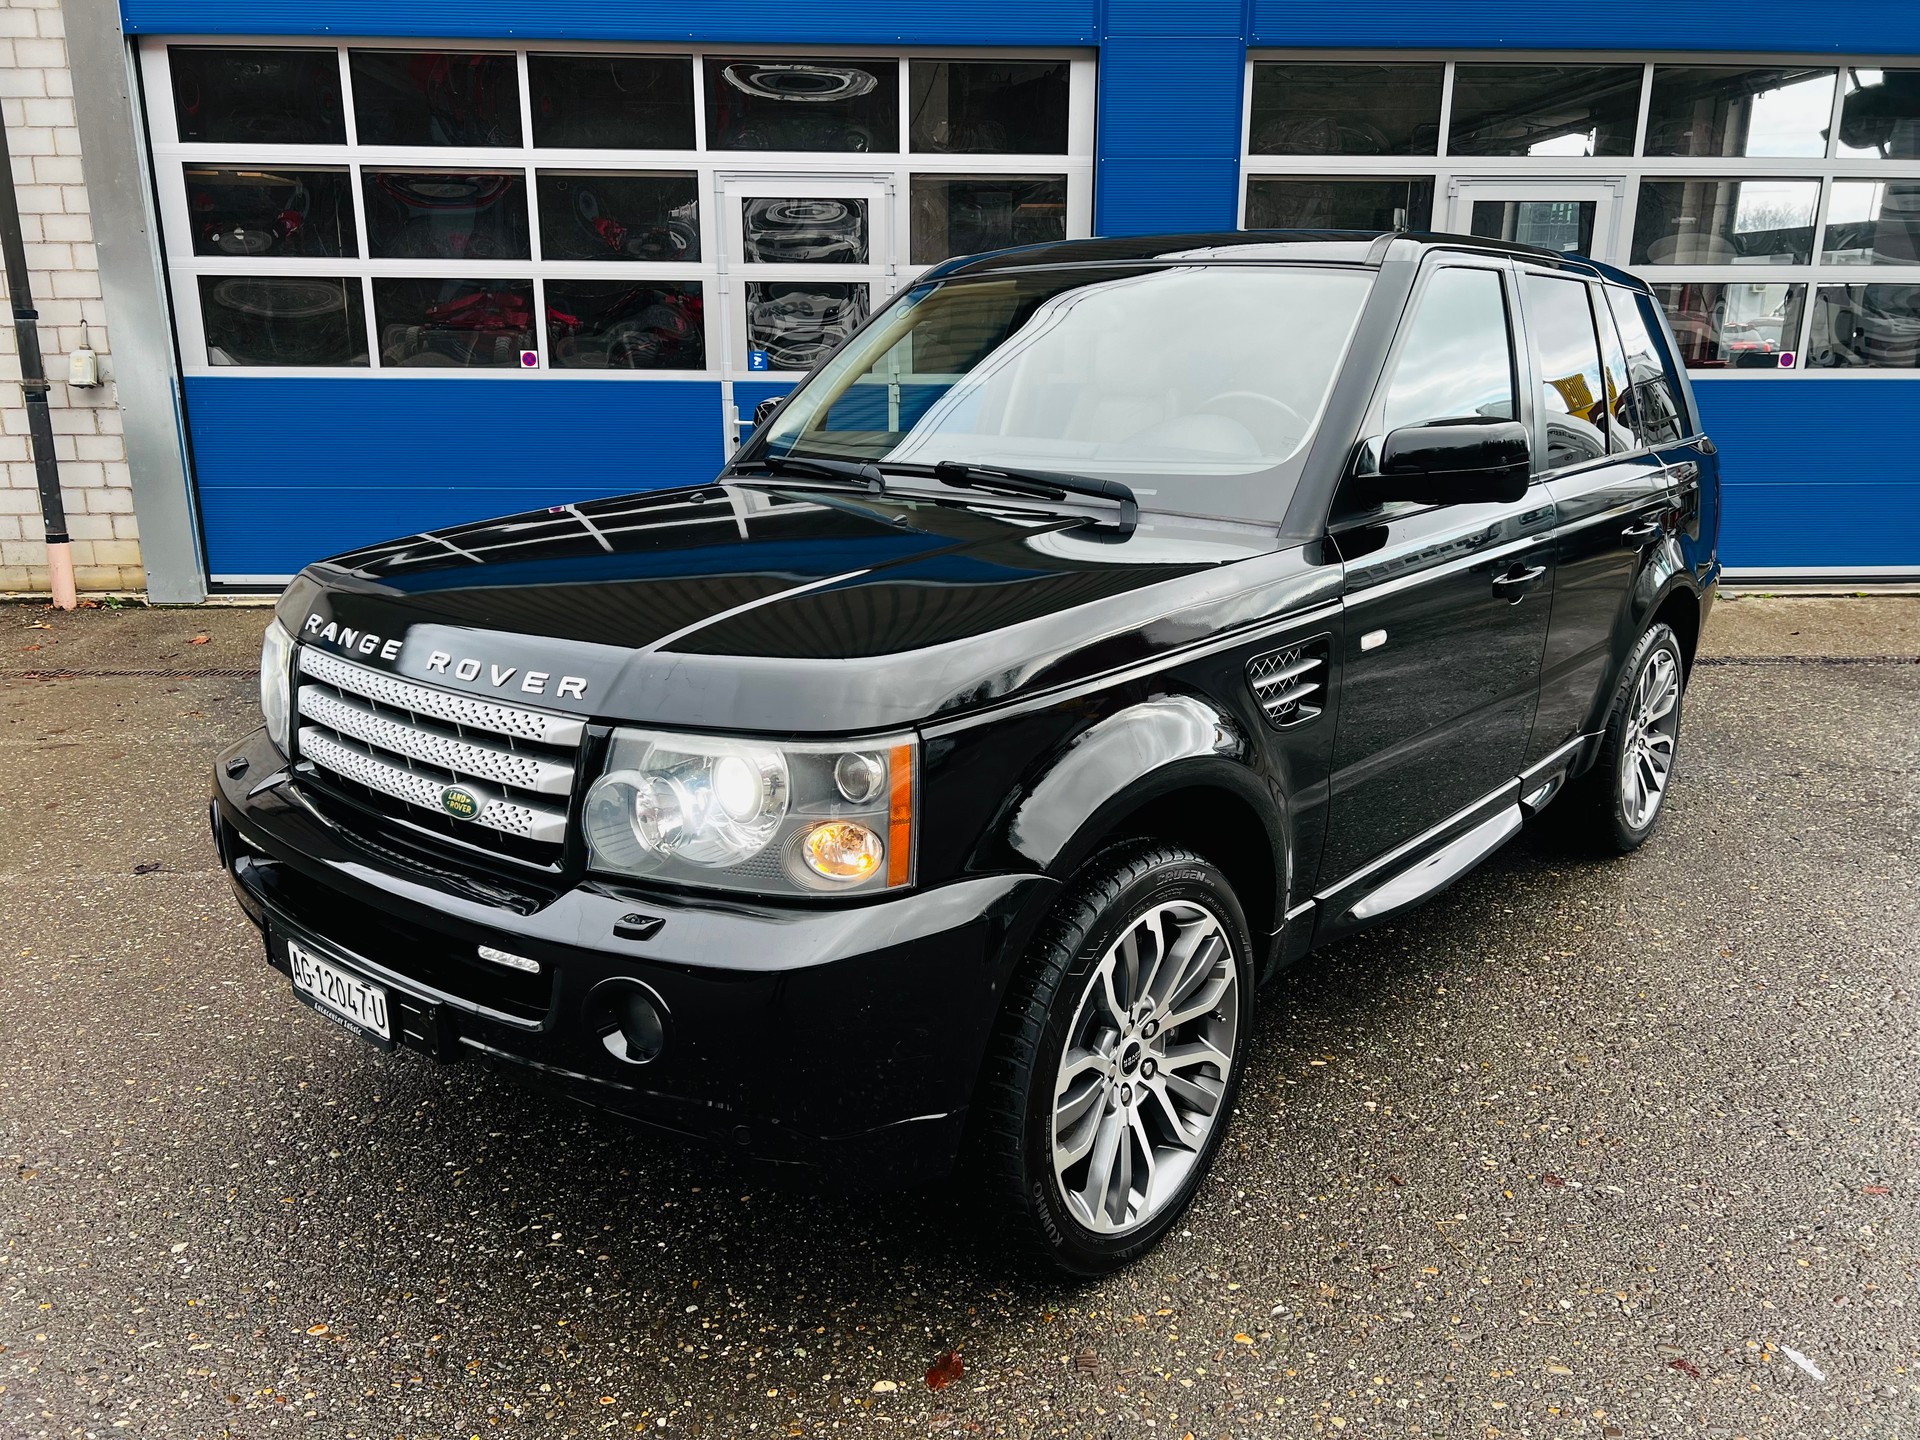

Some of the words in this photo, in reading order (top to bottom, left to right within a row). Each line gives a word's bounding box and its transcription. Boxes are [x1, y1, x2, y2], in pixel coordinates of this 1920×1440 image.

[304, 613, 403, 661] RANGE
[426, 650, 588, 700] ROVER
[448, 791, 467, 803] LAND
[450, 801, 472, 814] ROVER
[1033, 1181, 1064, 1248] KUMHO
